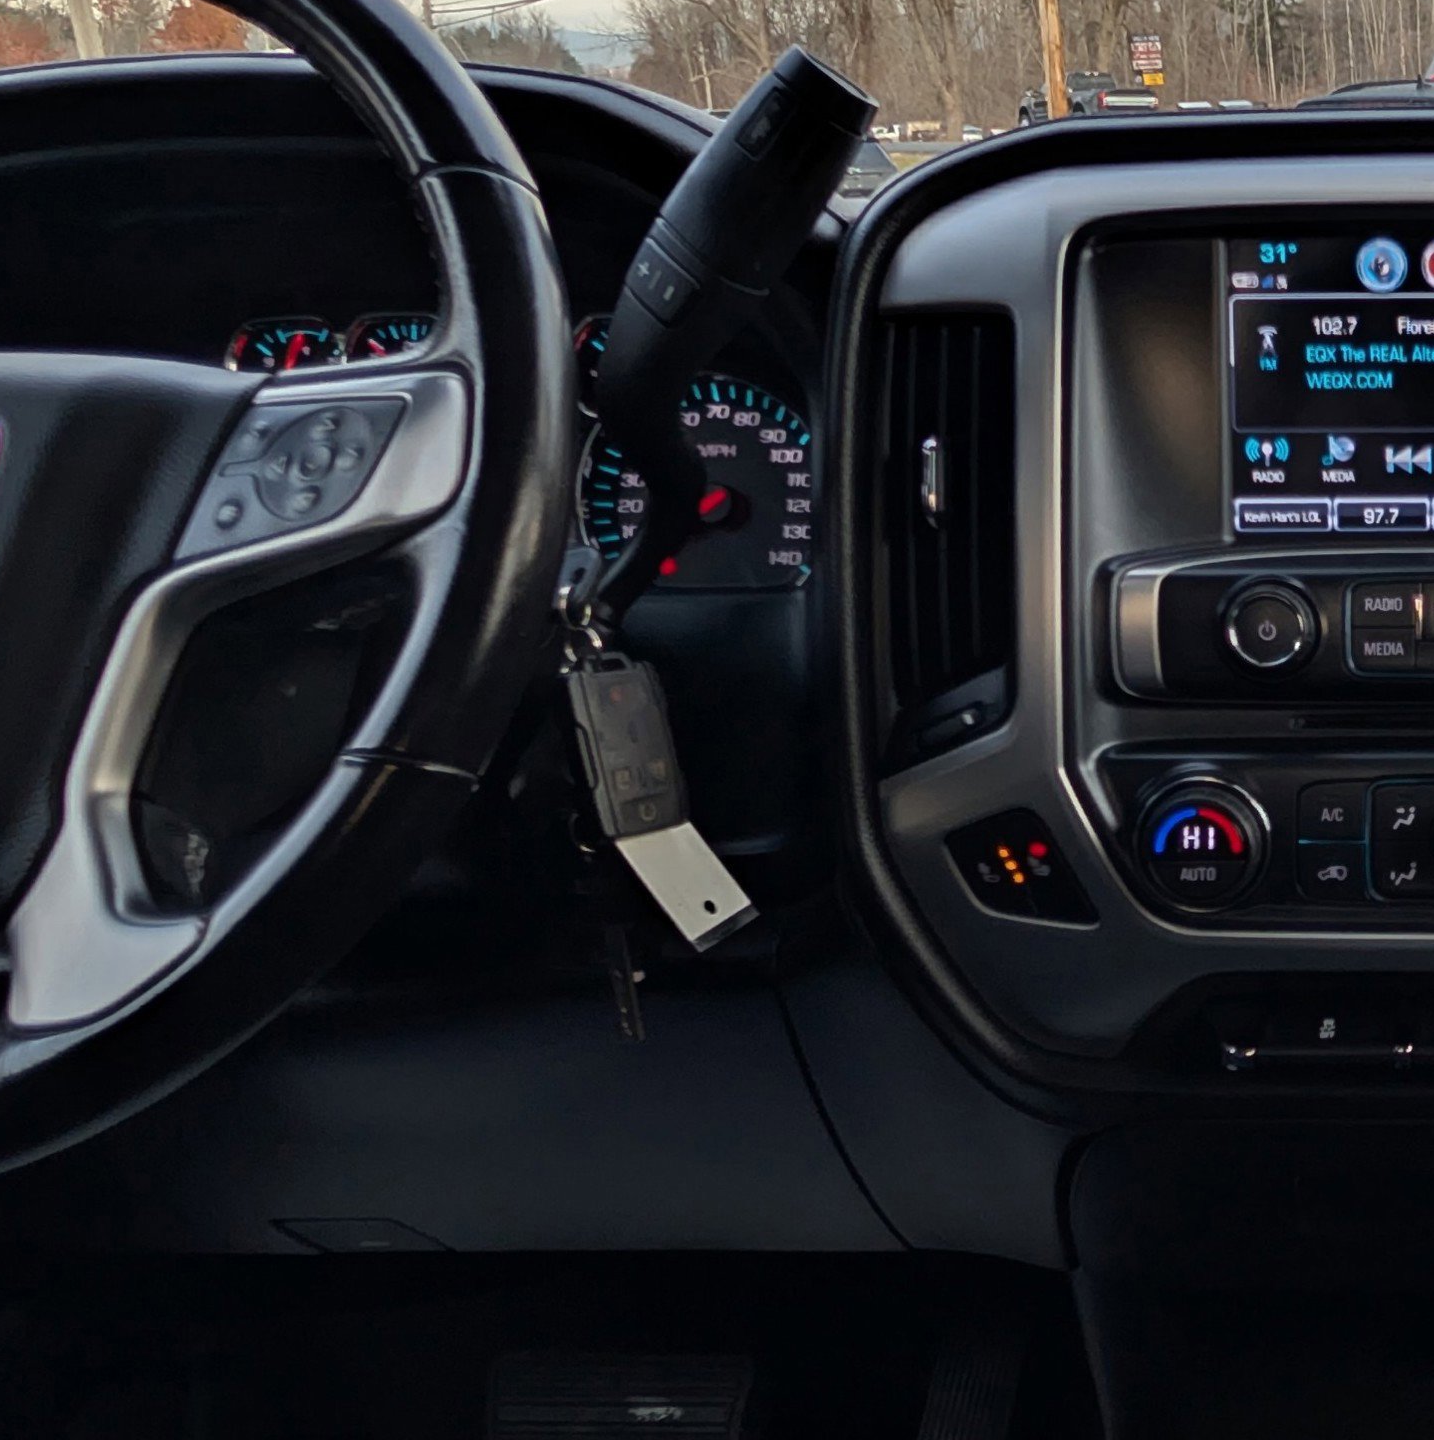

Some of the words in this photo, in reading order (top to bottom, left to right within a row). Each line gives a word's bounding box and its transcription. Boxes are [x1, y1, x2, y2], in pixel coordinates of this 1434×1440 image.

[1312, 316, 1358, 336] 102.7
[1340, 344, 1365, 363] The
[1370, 344, 1408, 363] REAL
[706, 404, 731, 420] 70
[733, 411, 761, 427] 80
[759, 428, 787, 444] 90
[697, 444, 737, 458] MPH
[770, 448, 804, 463] 100
[1252, 471, 1286, 483] RADIO
[1321, 470, 1356, 483] MEDIA
[617, 498, 645, 514] 20
[1363, 507, 1400, 525] 97.7
[768, 550, 803, 566] 140
[1364, 597, 1404, 613] RADIO
[1363, 641, 1405, 657] MEDIA
[1320, 807, 1345, 824] A/C
[1182, 825, 1217, 851] HI
[1179, 865, 1217, 883] AUTO
